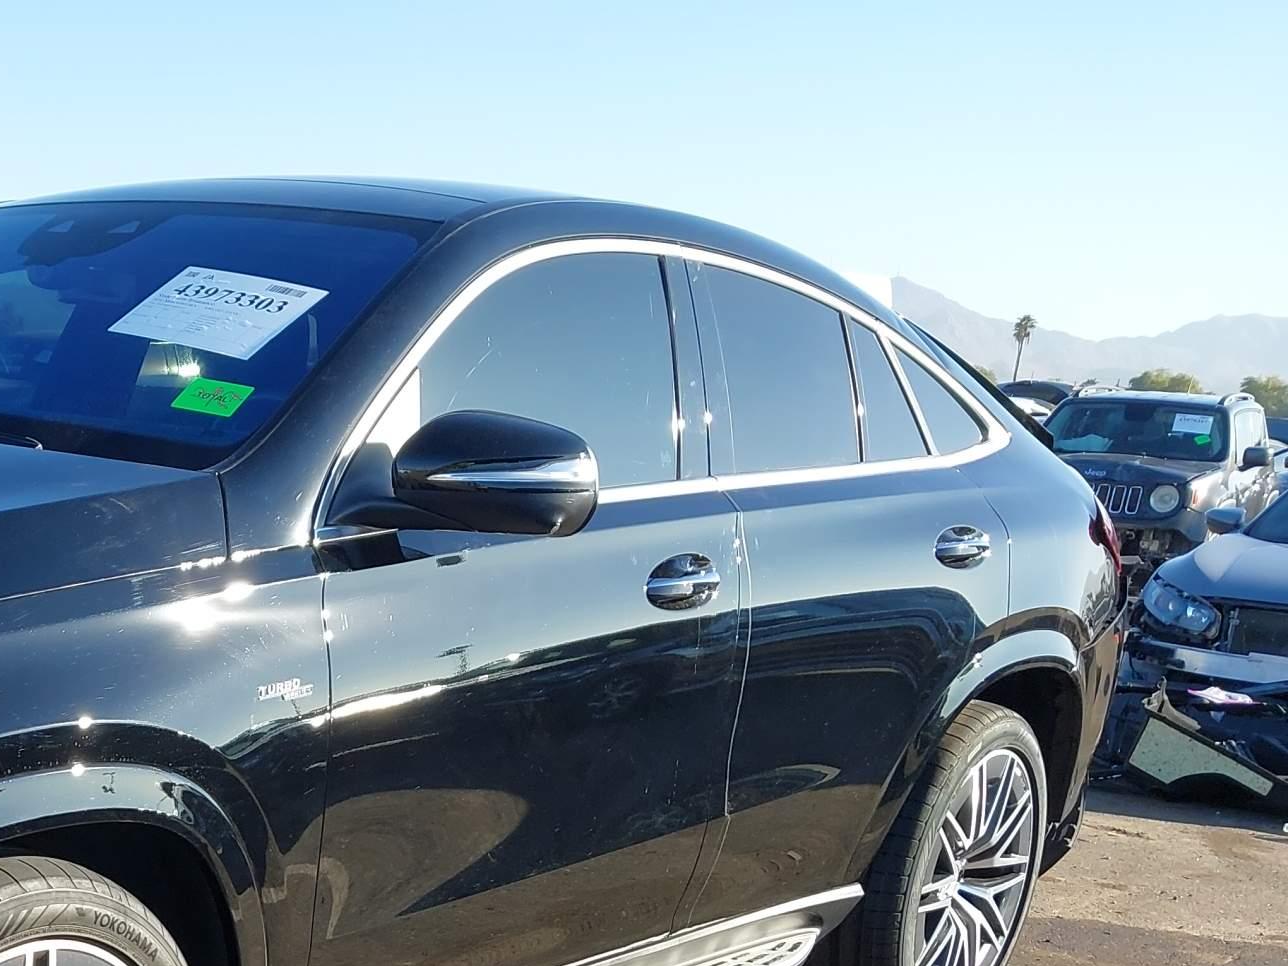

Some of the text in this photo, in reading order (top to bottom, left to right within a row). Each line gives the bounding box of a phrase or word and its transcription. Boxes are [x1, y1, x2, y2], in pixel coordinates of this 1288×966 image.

[173, 282, 289, 314] 43973303
[1084, 468, 1107, 477] Jeep
[257, 678, 301, 700] TURBO
[93, 909, 159, 963] YOKOHAMA
